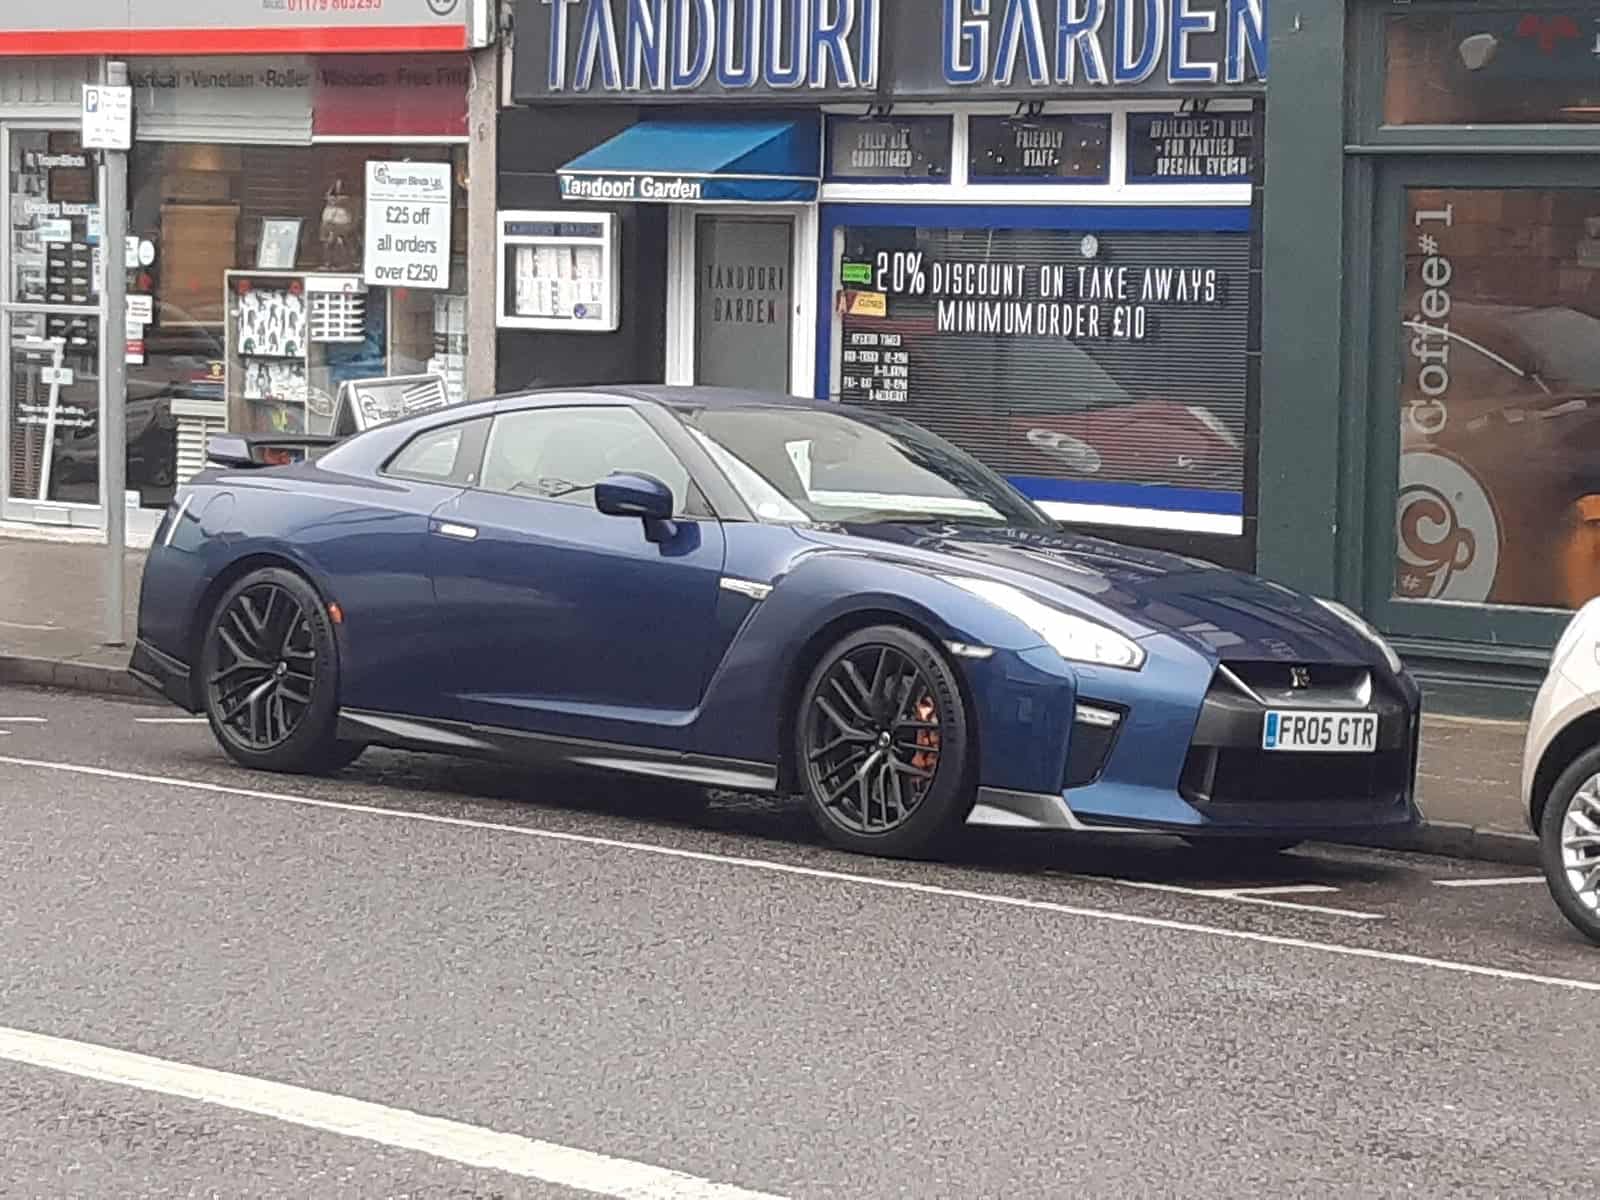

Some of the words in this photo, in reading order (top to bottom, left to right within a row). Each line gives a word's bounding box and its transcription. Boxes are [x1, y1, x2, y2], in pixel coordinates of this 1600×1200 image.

[541, 0, 880, 91] TANDOORI
[942, 0, 1267, 85] GARDEN
[561, 175, 635, 197] Tandoori
[640, 177, 702, 199] Garden
[385, 205, 410, 225] £25
[412, 207, 431, 225] off
[376, 233, 393, 252] all
[394, 235, 438, 255] orders
[374, 265, 405, 280] over
[406, 263, 439, 282] £250
[703, 264, 784, 291] TANDOORI
[876, 251, 926, 295] 20%
[932, 262, 1026, 297] DISCOUNT
[1040, 264, 1064, 298] ON
[1078, 266, 1128, 300] TAKE
[1141, 269, 1217, 302] AWAYS
[1112, 306, 1147, 339] £10
[1278, 715, 1333, 745] FR05
[1337, 717, 1375, 747] GTR
